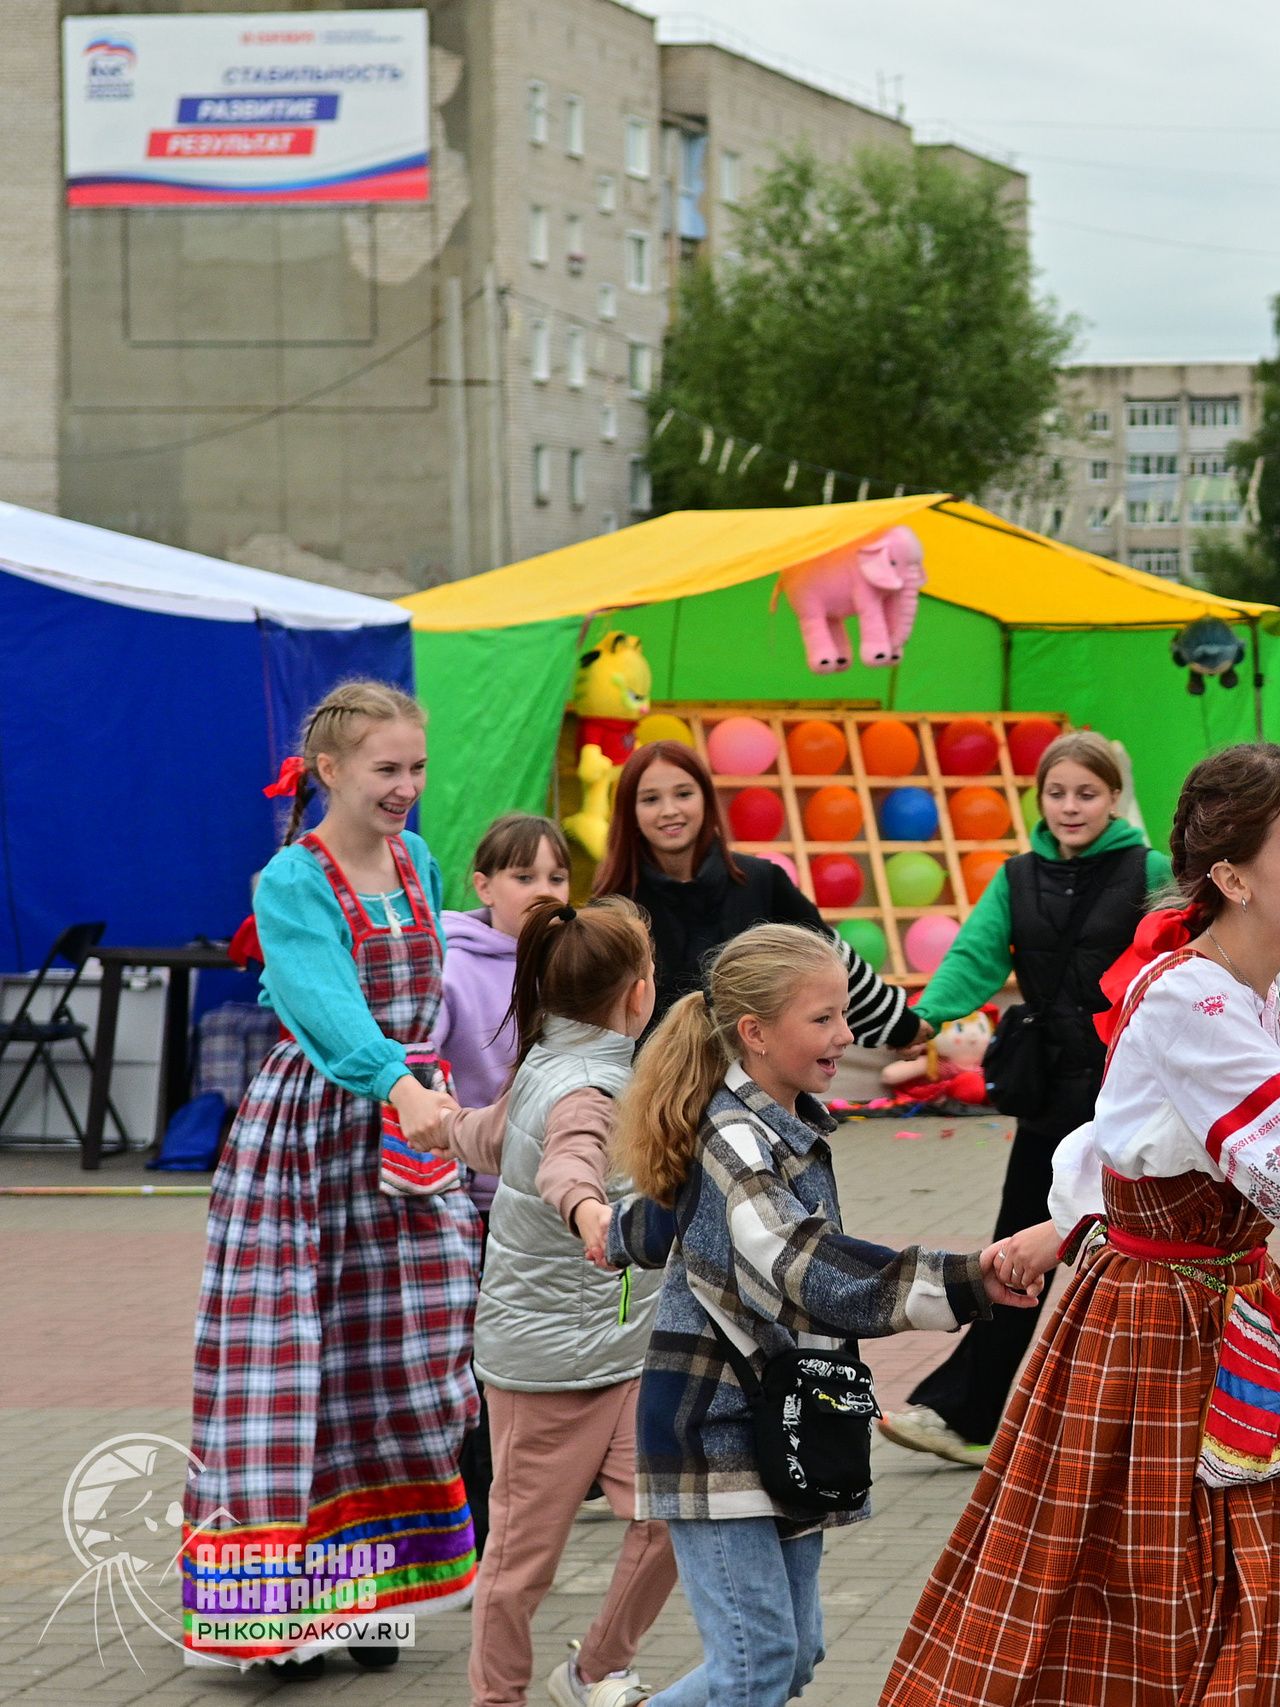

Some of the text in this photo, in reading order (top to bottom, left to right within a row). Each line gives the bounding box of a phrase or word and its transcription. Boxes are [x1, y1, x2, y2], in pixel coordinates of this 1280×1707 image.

[222, 64, 404, 85] СТАБИЛЬНОСТЬ
[197, 97, 319, 121] РАЗВИТИЕ
[166, 131, 295, 155] РЕЗУЛЬТАТ
